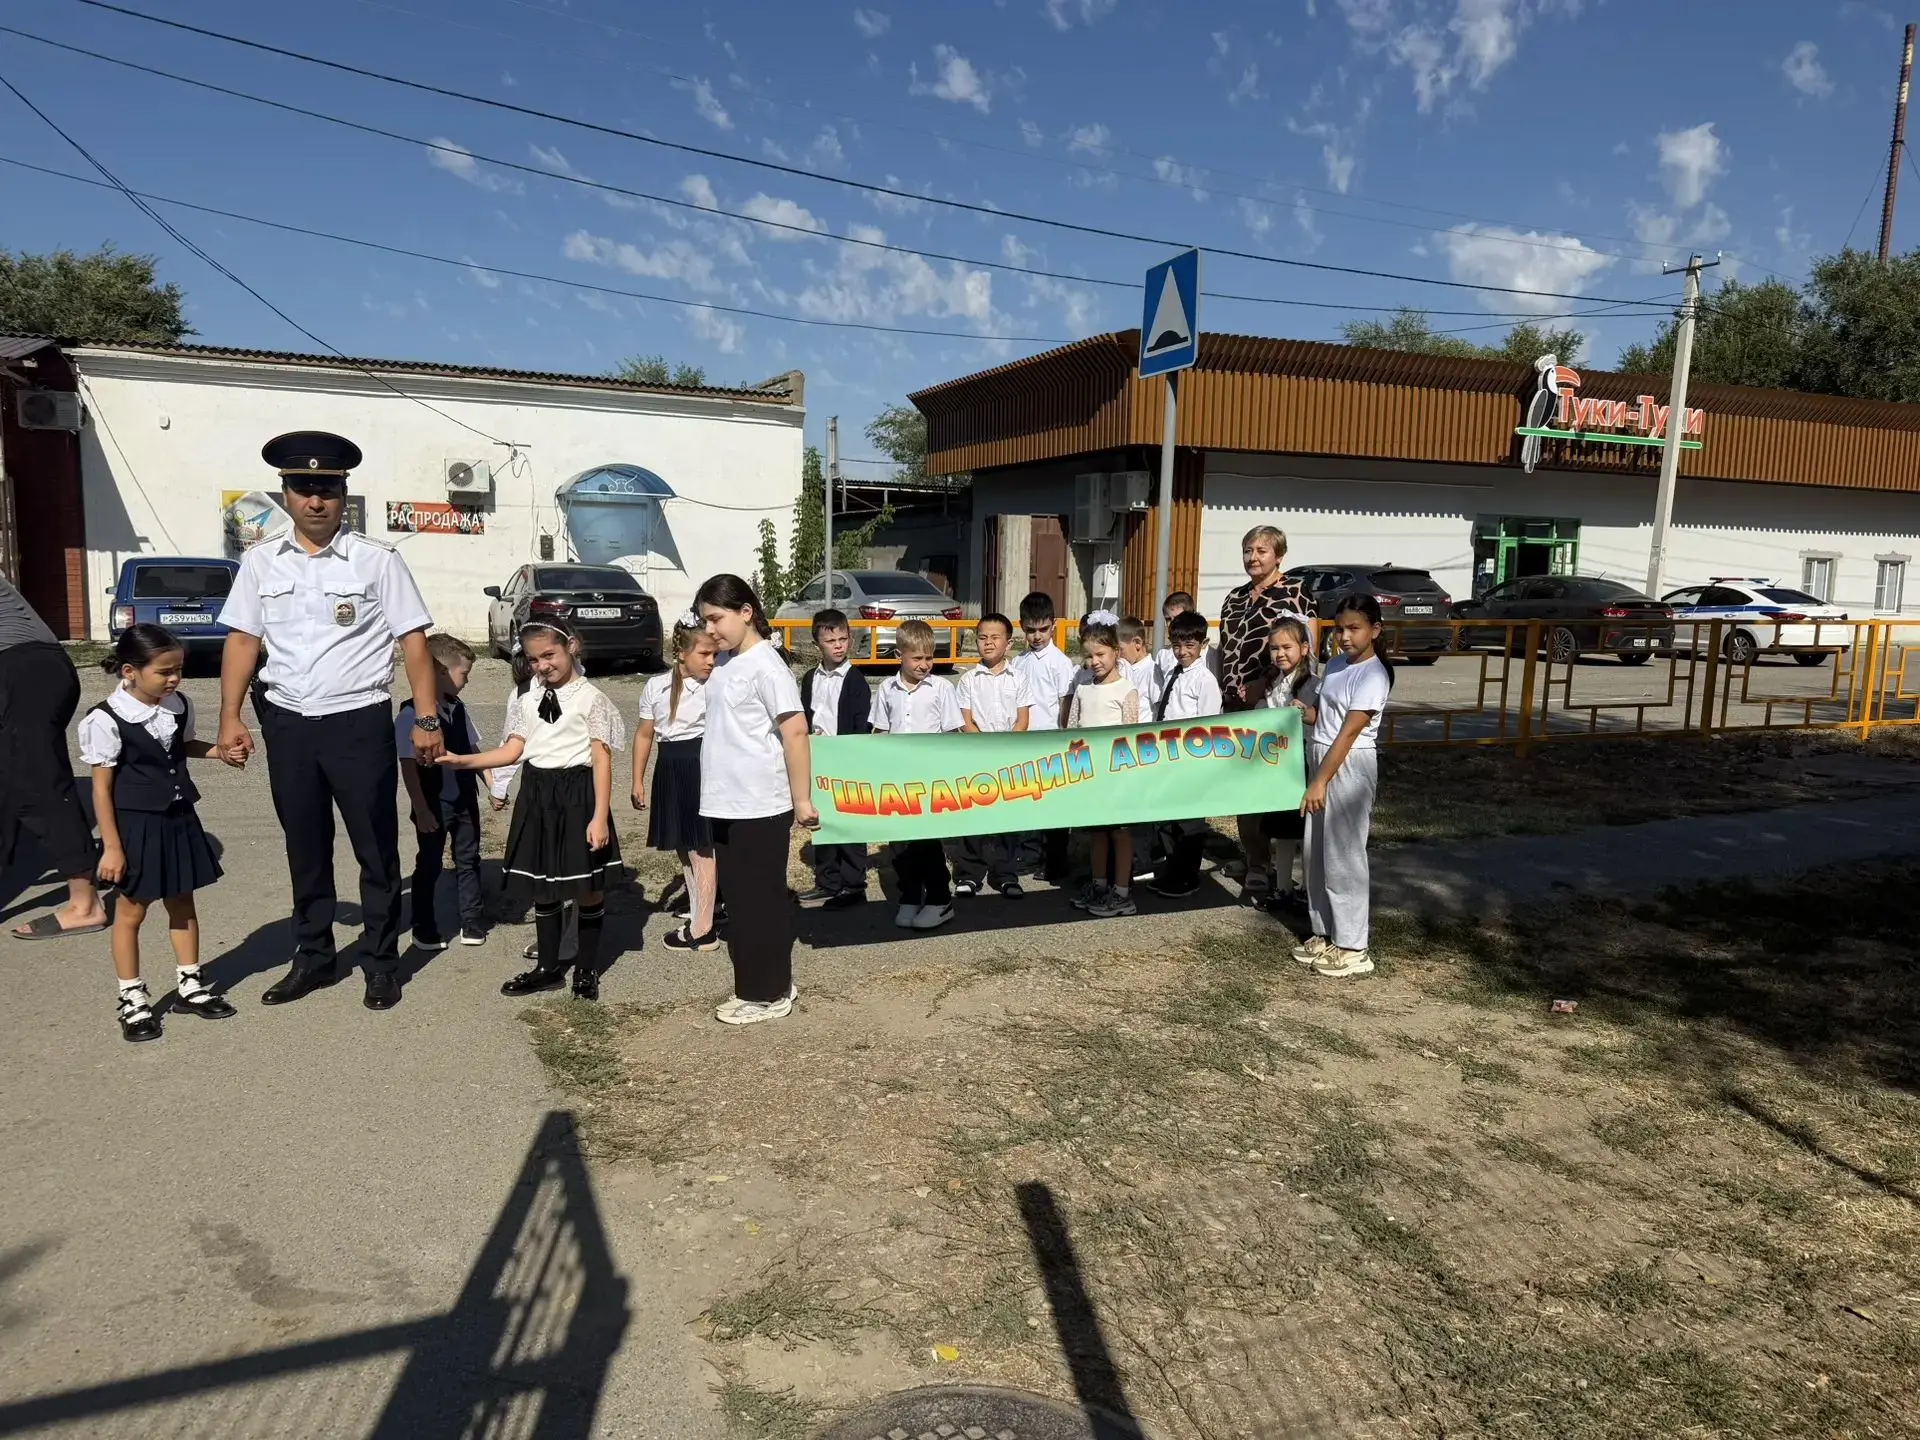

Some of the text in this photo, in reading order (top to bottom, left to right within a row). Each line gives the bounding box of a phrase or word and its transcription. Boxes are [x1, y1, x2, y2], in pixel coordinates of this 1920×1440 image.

[1558, 387, 1704, 440] Туки-Туи
[390, 510, 480, 529] РАСПРОДАЖА
[815, 726, 1289, 816] "ШАГАЮЩИЙ АВТОБУС"
